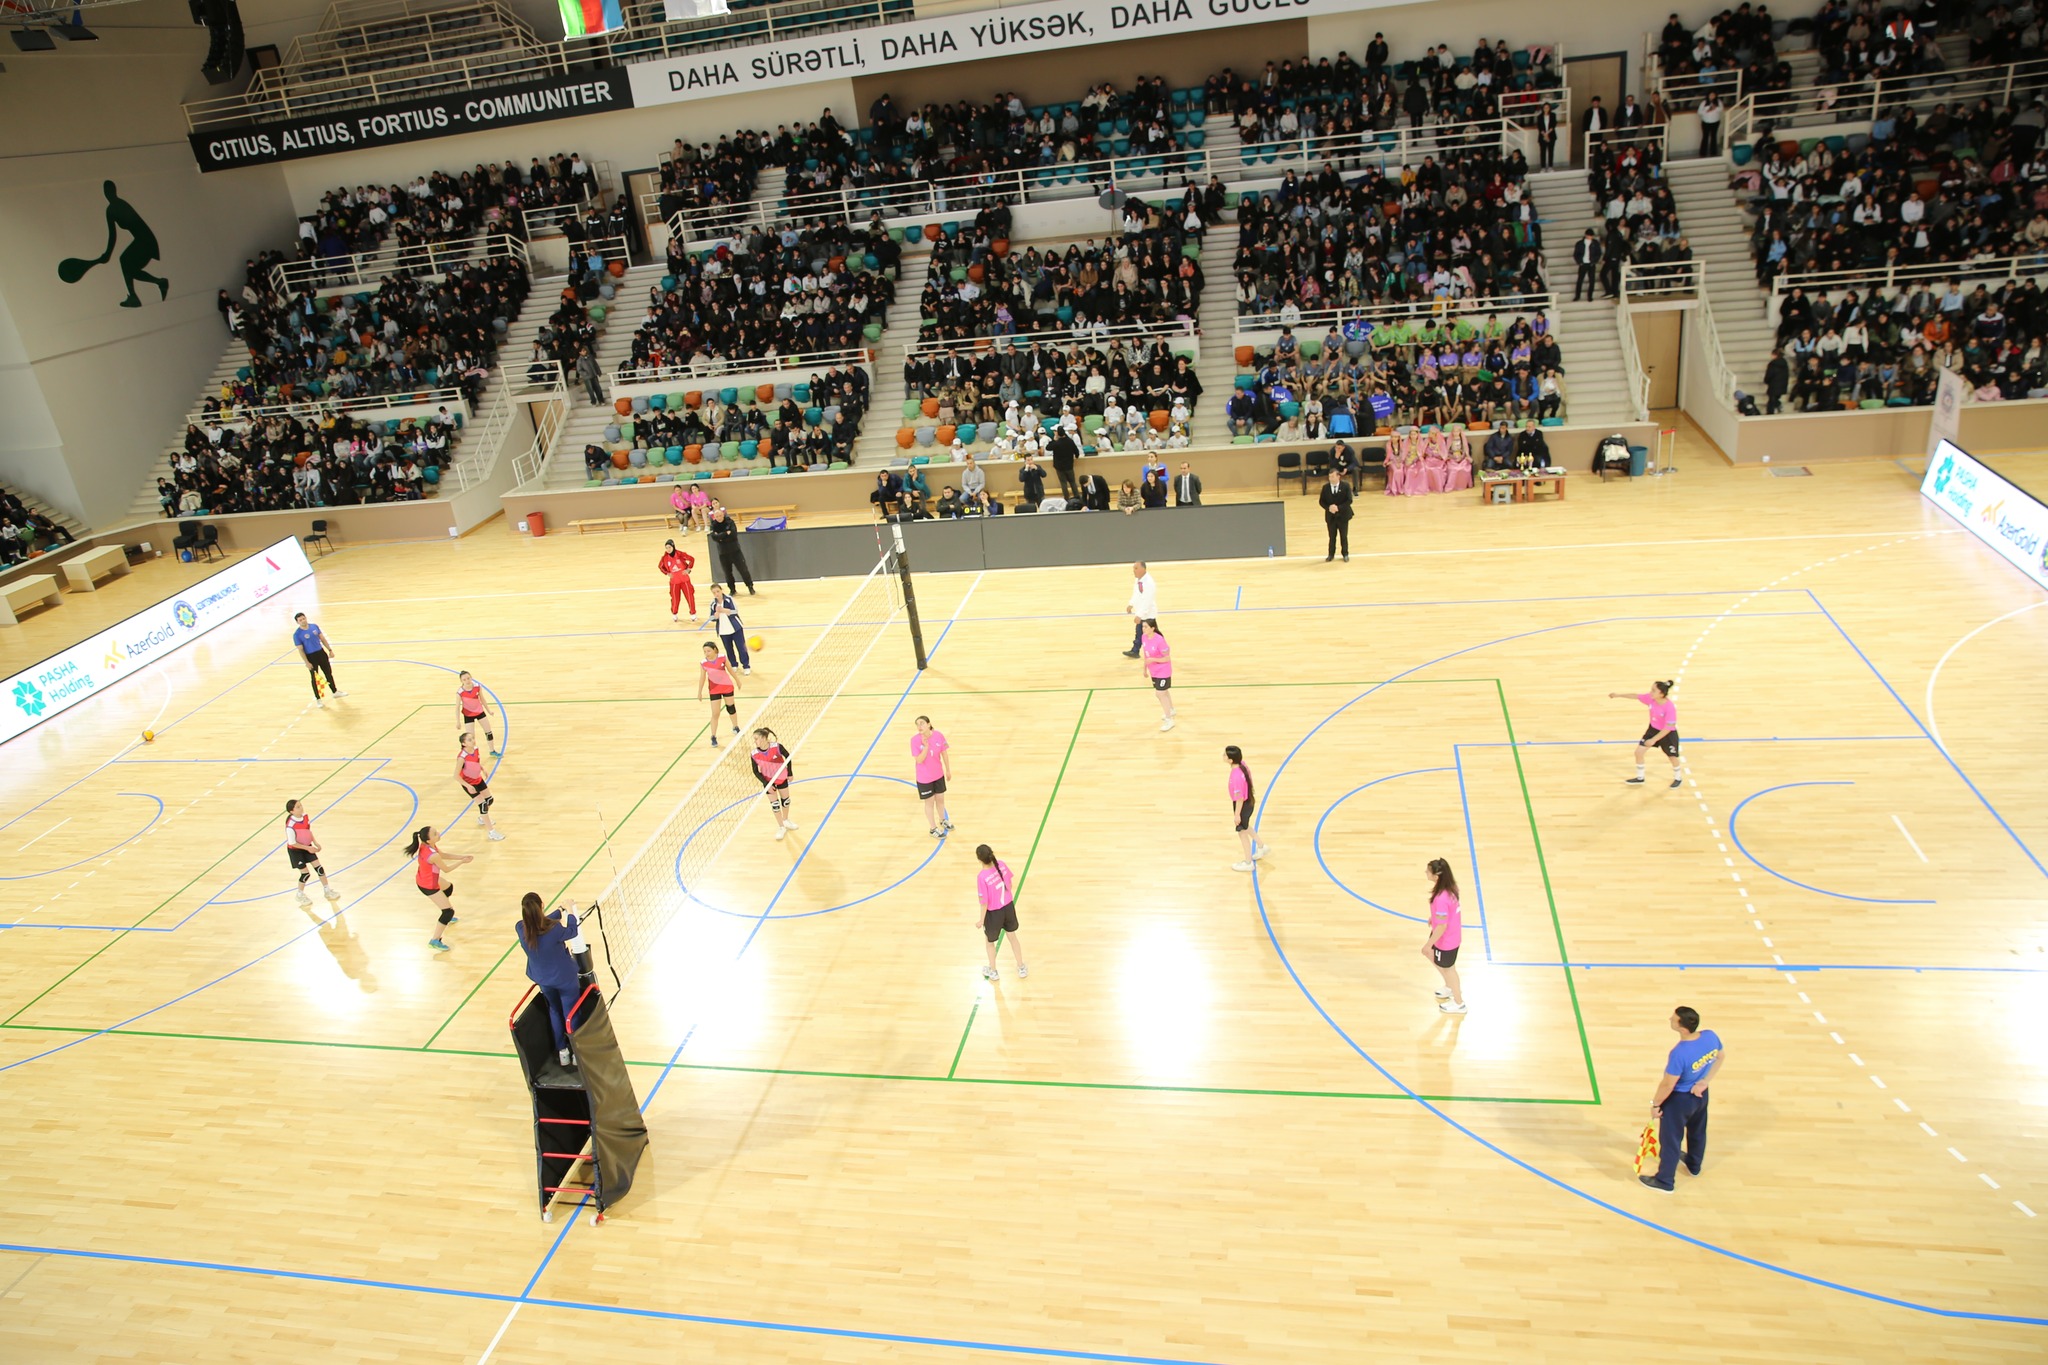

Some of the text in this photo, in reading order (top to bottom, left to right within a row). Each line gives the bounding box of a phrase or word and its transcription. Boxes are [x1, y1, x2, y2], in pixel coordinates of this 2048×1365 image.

[668, 62, 739, 92] DAHA
[751, 38, 865, 80] SÜRƏTLİ,
[881, 30, 958, 61] DAHA
[970, 11, 1094, 47] YÜKSƏK,
[1111, 0, 1193, 29] DAHA
[209, 134, 277, 161] CITIUS,
[282, 122, 356, 151] ALTIUS,
[358, 106, 449, 139] FORTIUS
[465, 81, 613, 122] COMMUNITER
[1996, 515, 2041, 556] AzerGold
[126, 622, 175, 659] AzerGold
[39, 661, 78, 686] PASHA
[48, 673, 95, 703] Holding
[1669, 745, 1677, 753] 2
[995, 881, 1005, 906] 7
[1435, 949, 1441, 962] 4
